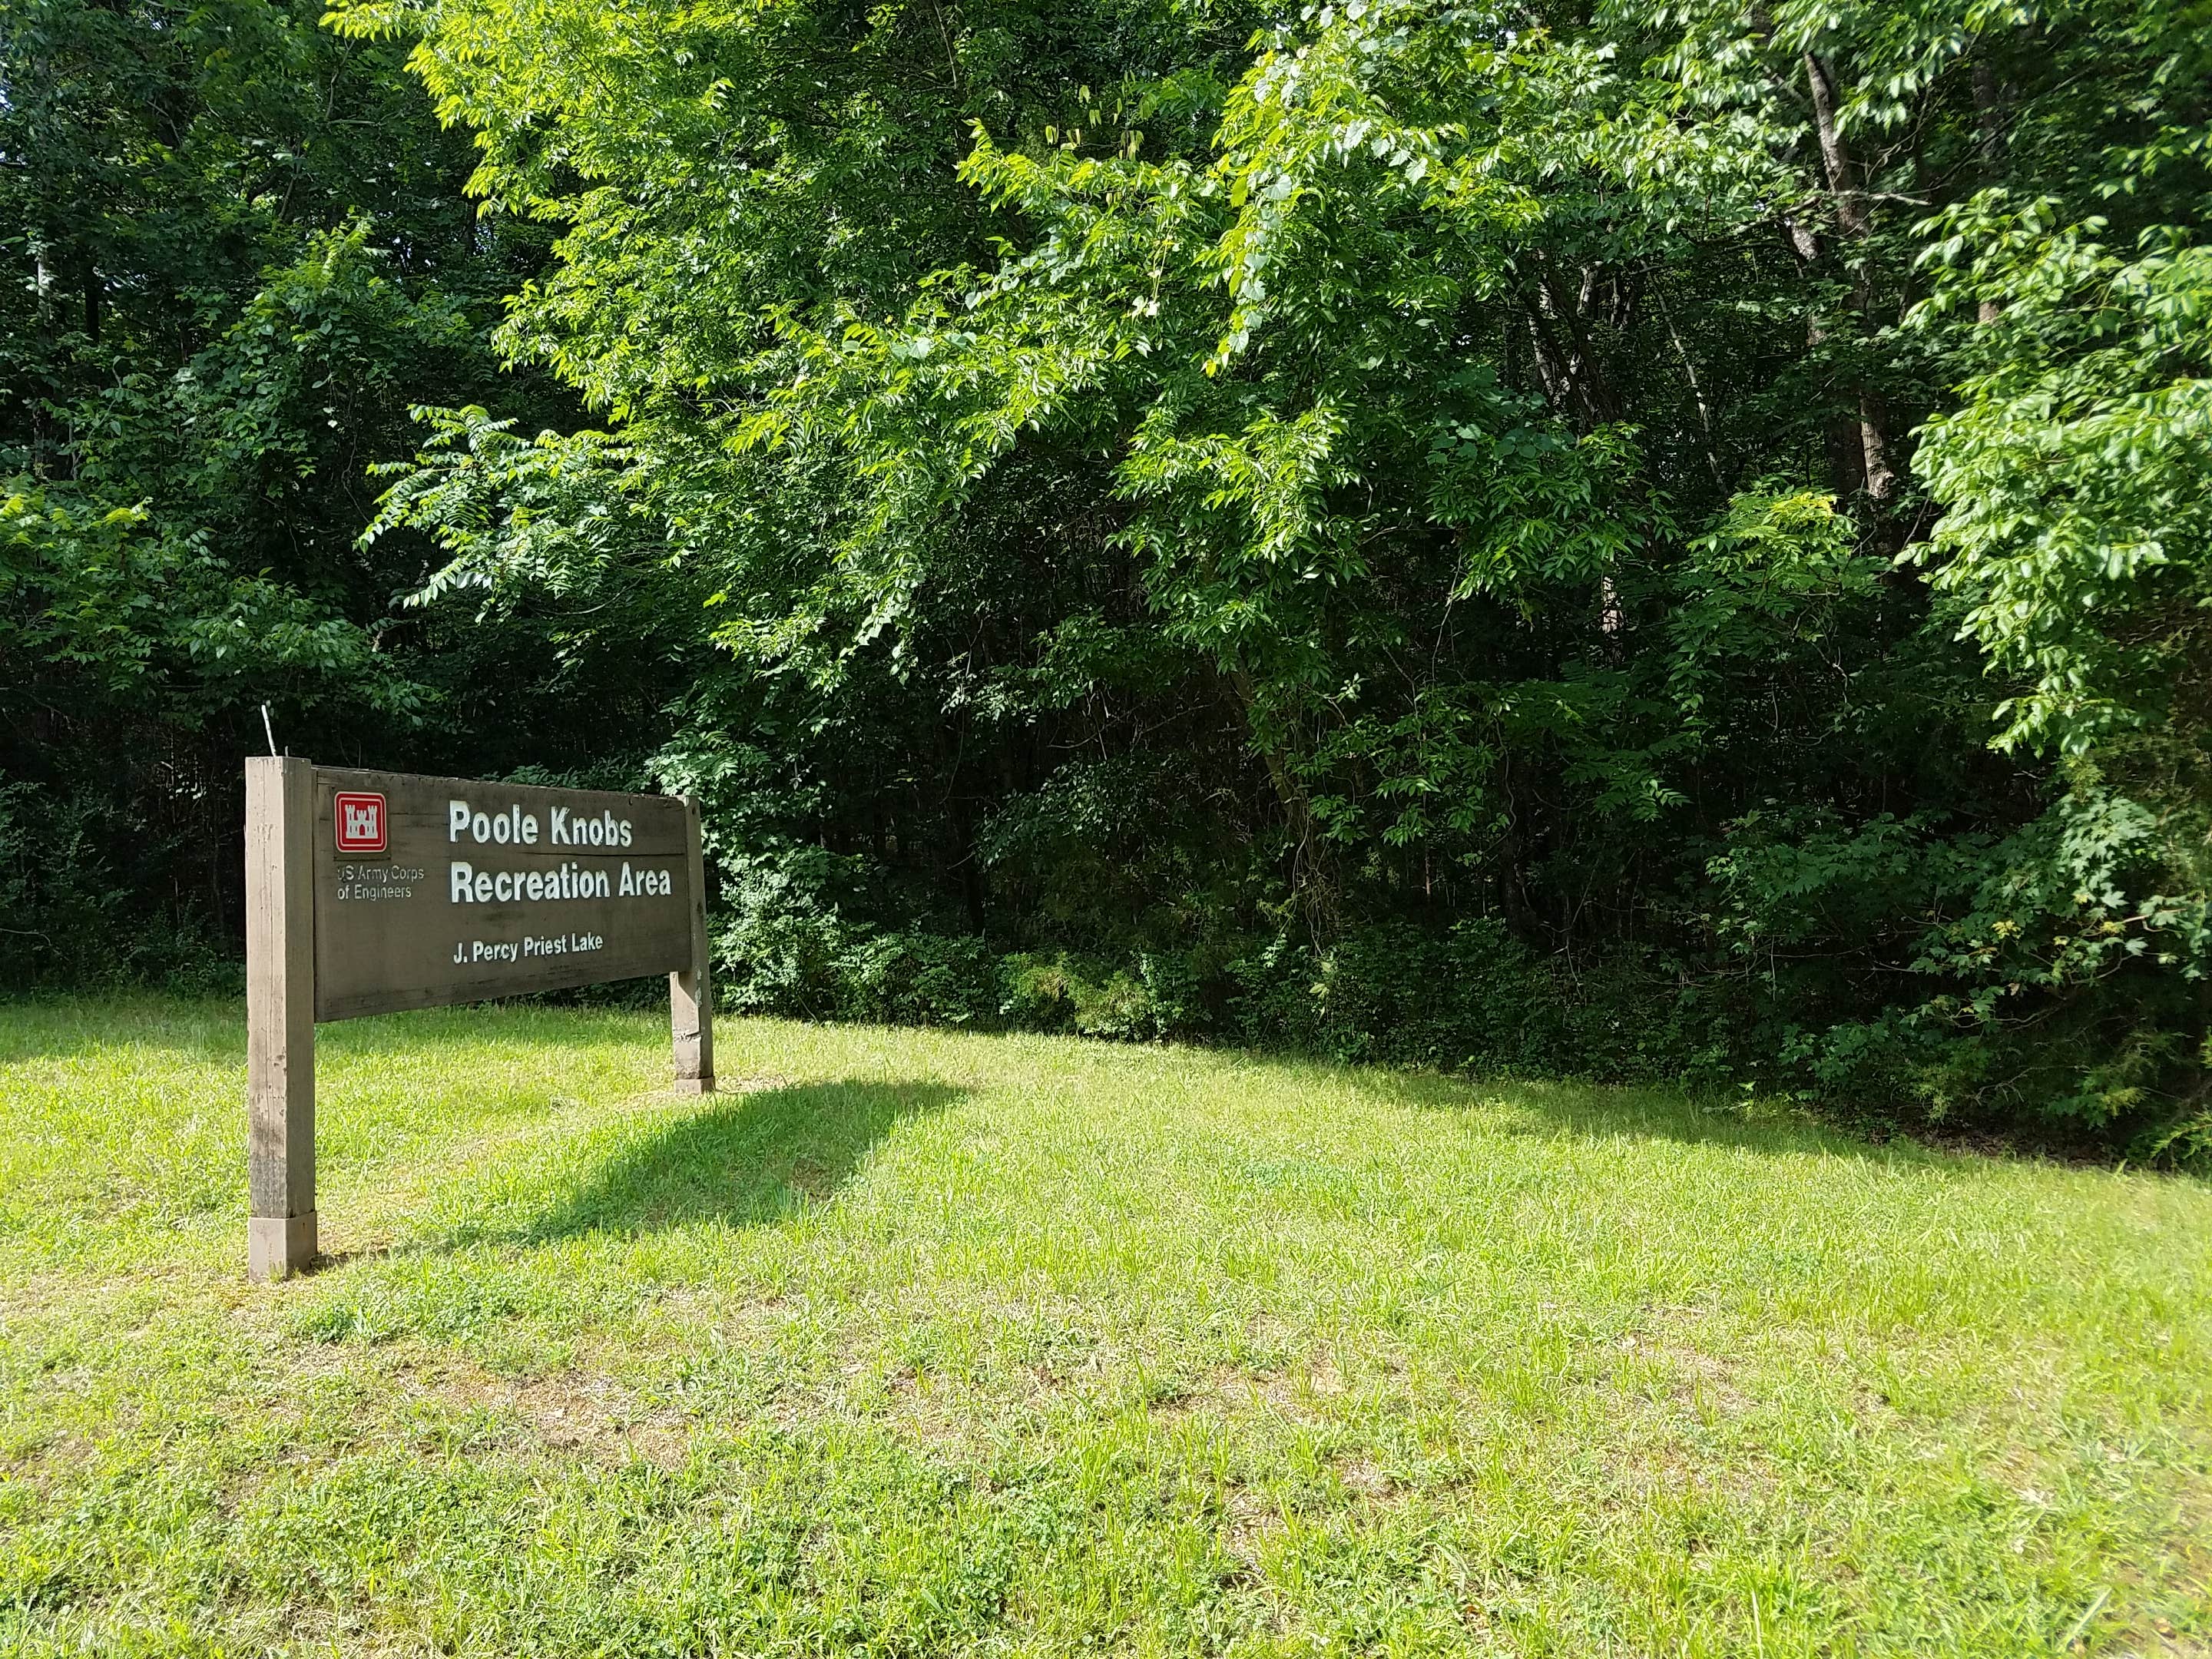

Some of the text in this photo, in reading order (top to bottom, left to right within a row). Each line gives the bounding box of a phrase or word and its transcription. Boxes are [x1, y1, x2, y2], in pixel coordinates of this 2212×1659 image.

[449, 800, 633, 846] Poole Knobs
[358, 865, 388, 883] Army
[391, 865, 424, 882] Corps
[451, 861, 672, 903] Recreation Area
[337, 884, 412, 901] of Engineers
[453, 932, 603, 964] J. Percy Priest Lake
